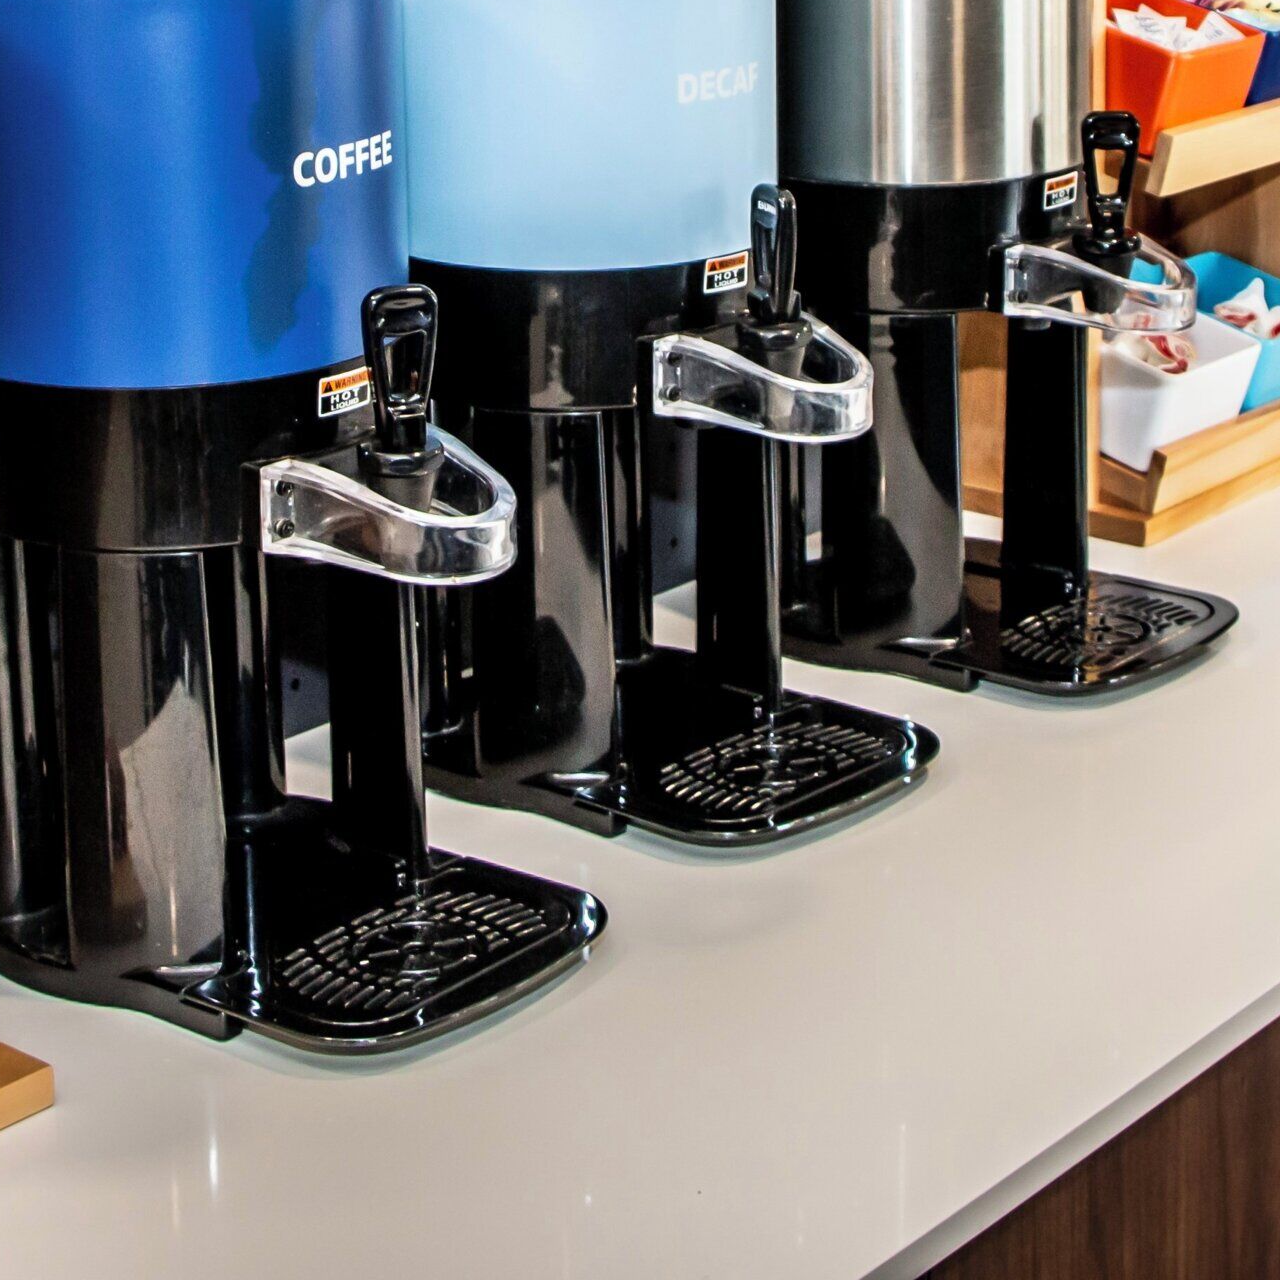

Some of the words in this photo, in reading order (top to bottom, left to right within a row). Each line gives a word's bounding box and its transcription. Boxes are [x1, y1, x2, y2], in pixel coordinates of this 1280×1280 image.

[677, 61, 759, 104] DECAF
[293, 130, 393, 188] COFFEE
[714, 270, 738, 282] HOT
[330, 387, 360, 404] HOT
[330, 397, 360, 411] LIQUID
